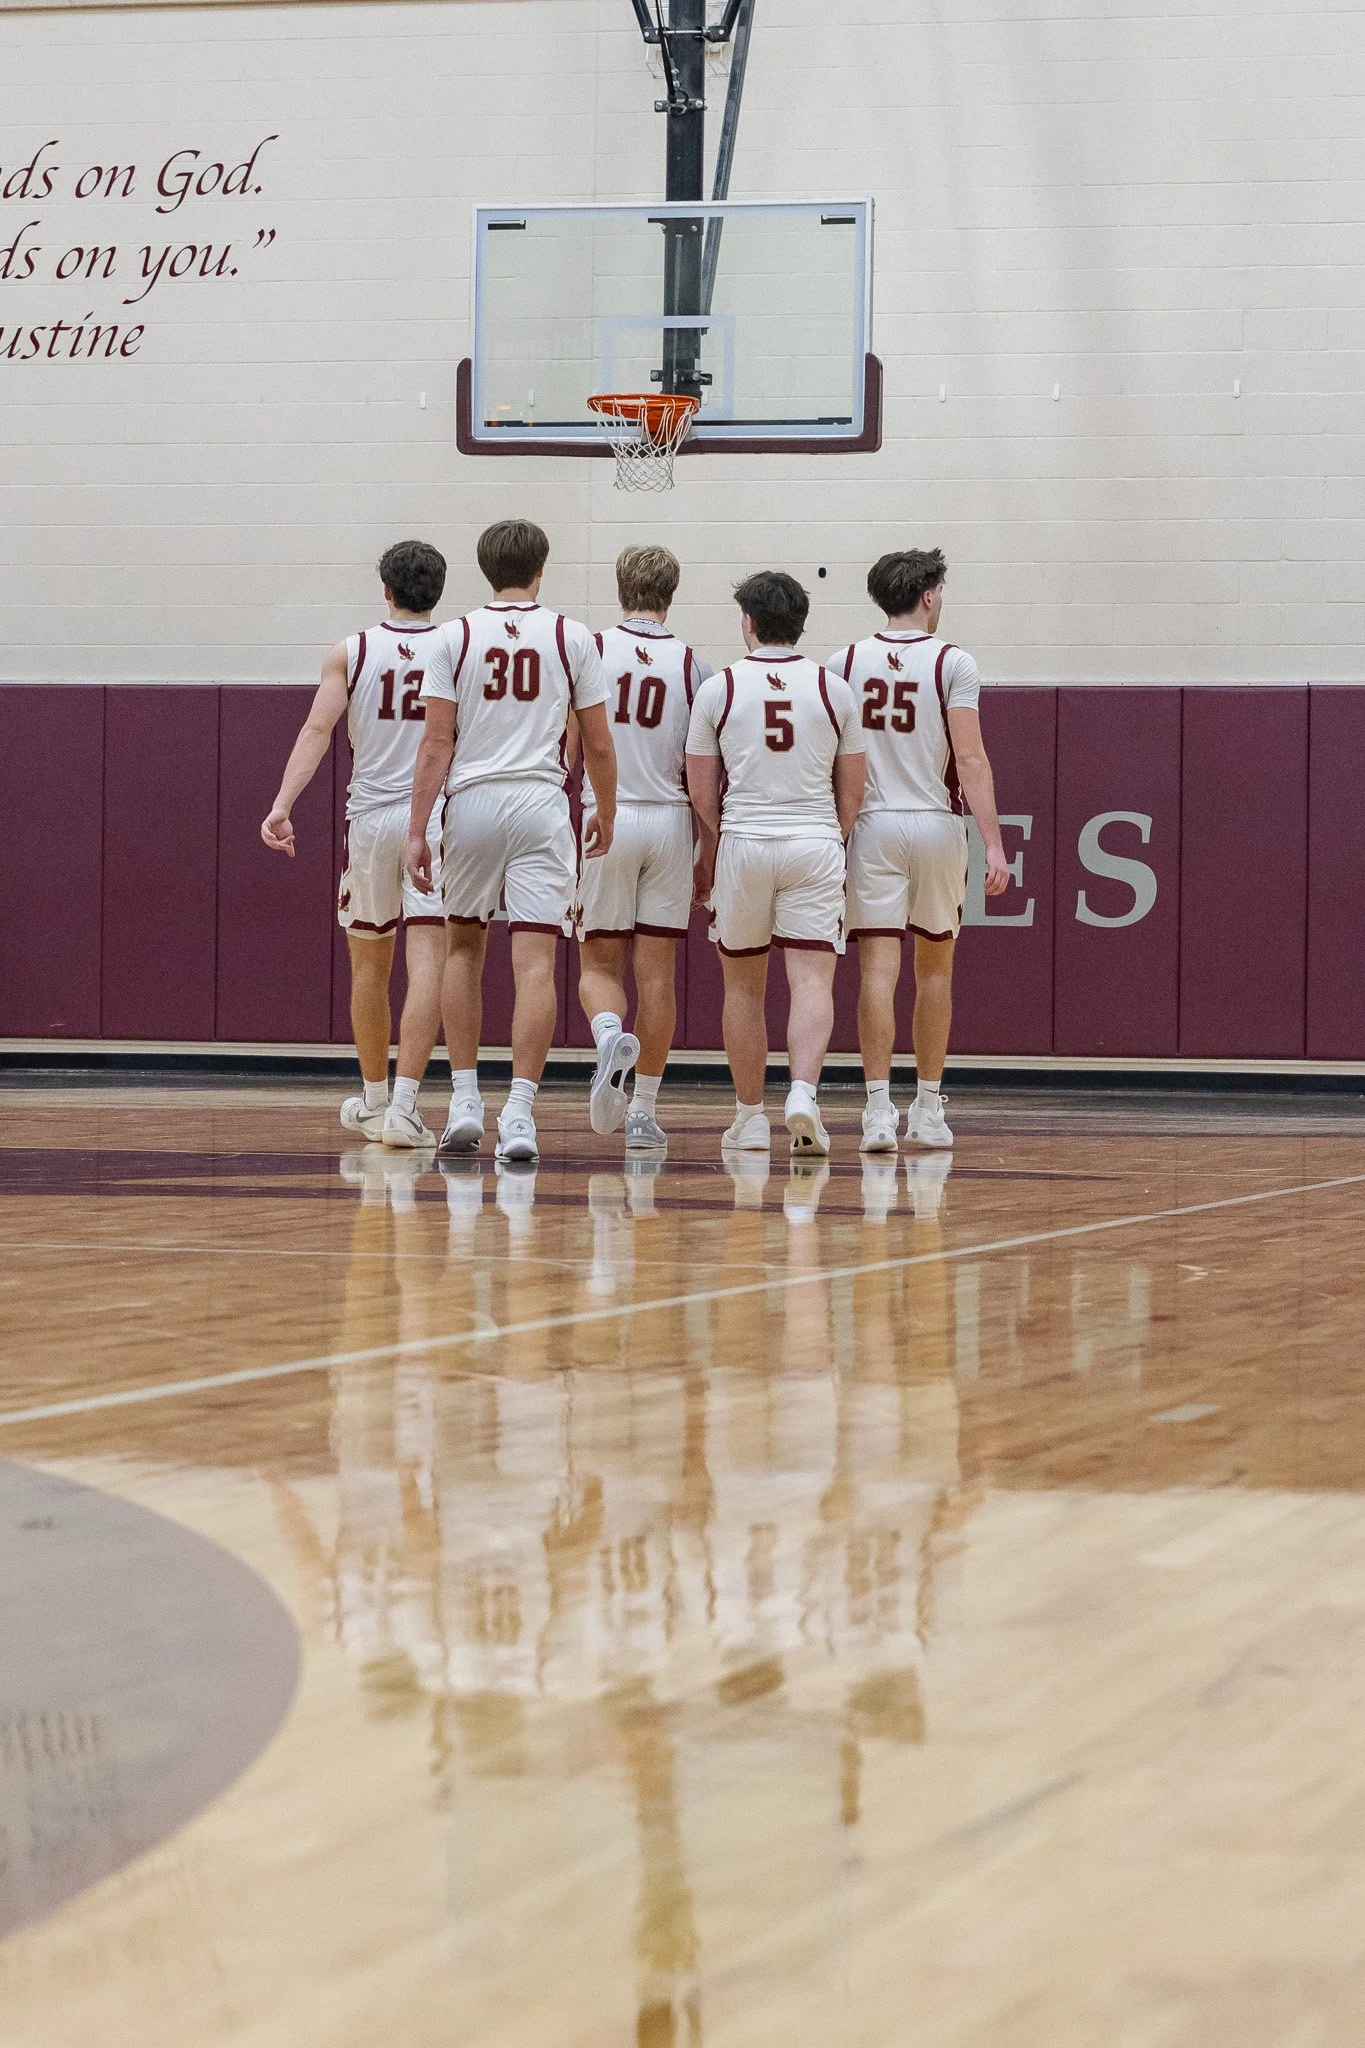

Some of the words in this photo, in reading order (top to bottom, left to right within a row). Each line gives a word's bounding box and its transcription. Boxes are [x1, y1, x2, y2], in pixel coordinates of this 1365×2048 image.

[0, 139, 60, 199] ds
[74, 165, 136, 199] on
[154, 134, 280, 214] God.
[55, 246, 117, 280] on
[121, 228, 277, 305] you.”
[377, 668, 427, 721] 12
[483, 647, 541, 702] 30
[613, 672, 667, 730] 10
[763, 700, 795, 753] 5
[862, 677, 919, 734] 25
